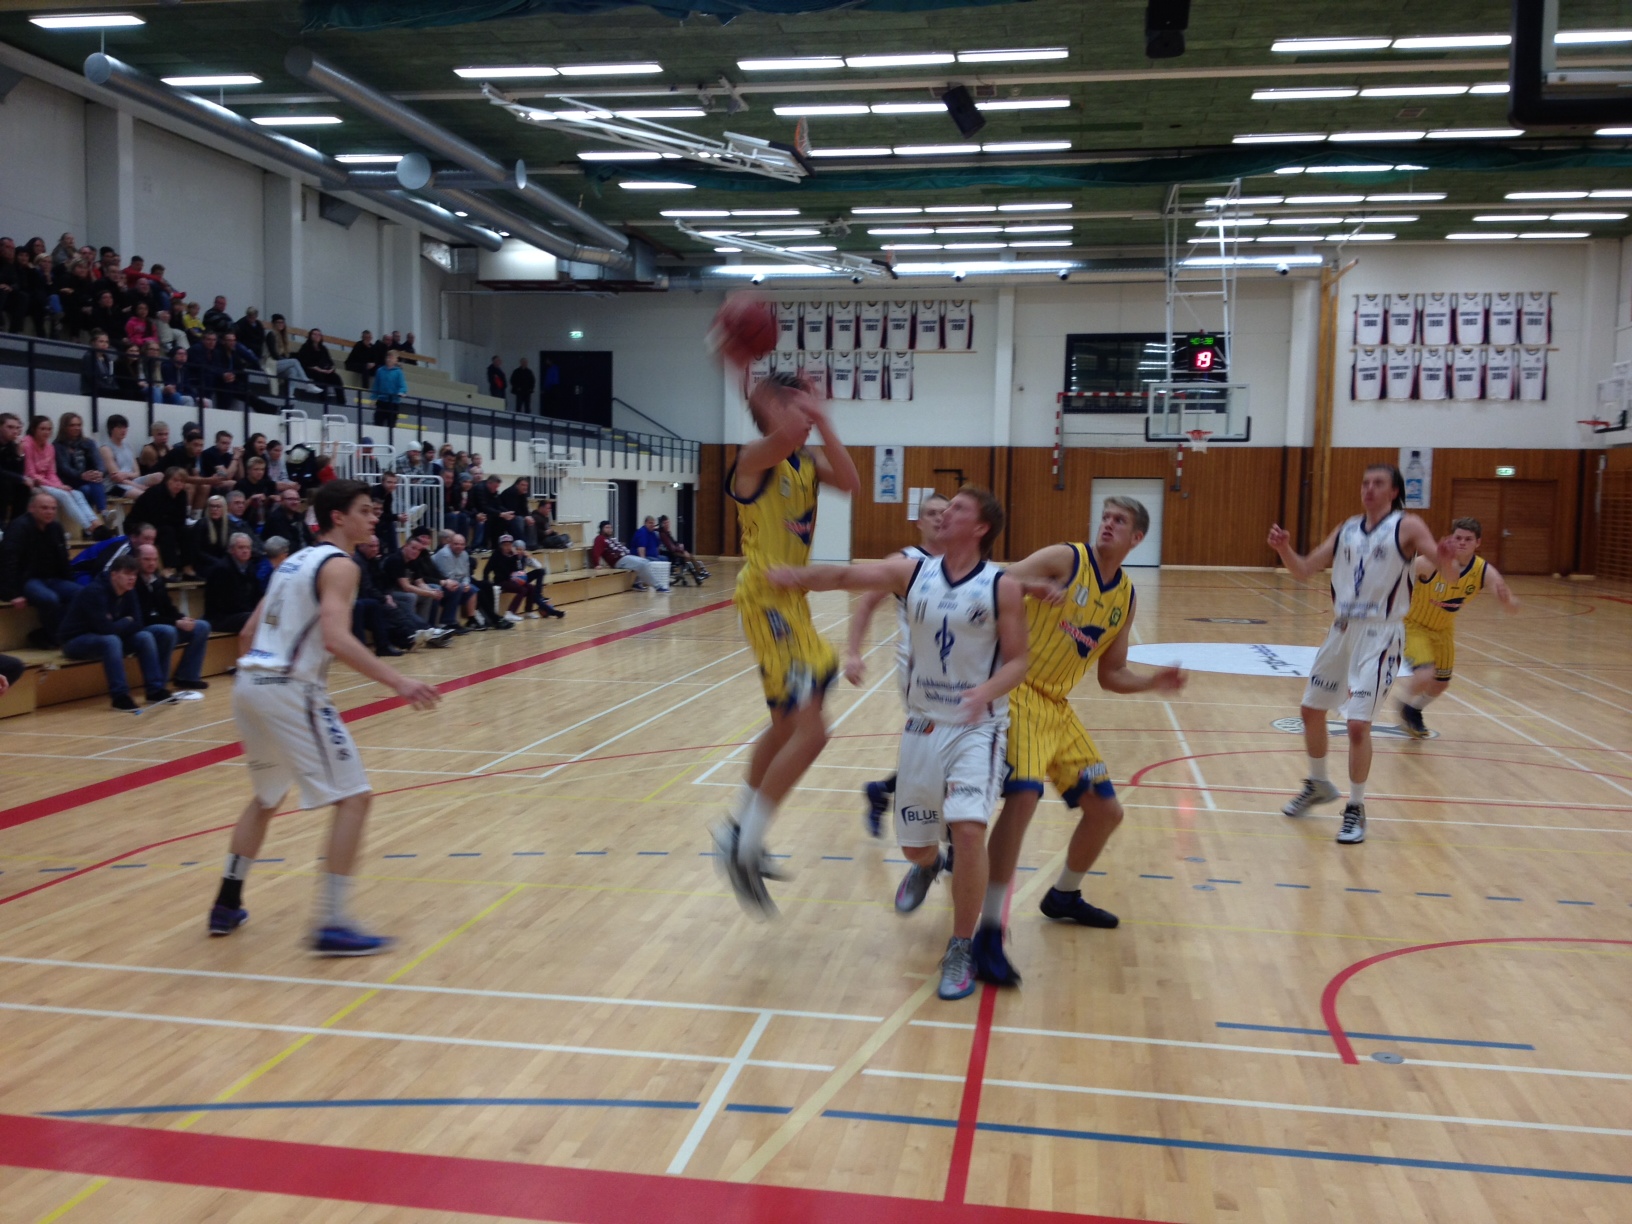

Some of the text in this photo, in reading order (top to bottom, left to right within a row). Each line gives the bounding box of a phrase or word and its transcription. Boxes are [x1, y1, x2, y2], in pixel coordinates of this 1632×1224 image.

[1073, 584, 1090, 607] 10
[1434, 582, 1446, 593] 11
[915, 597, 928, 625] 11
[907, 810, 939, 821] BLUE
